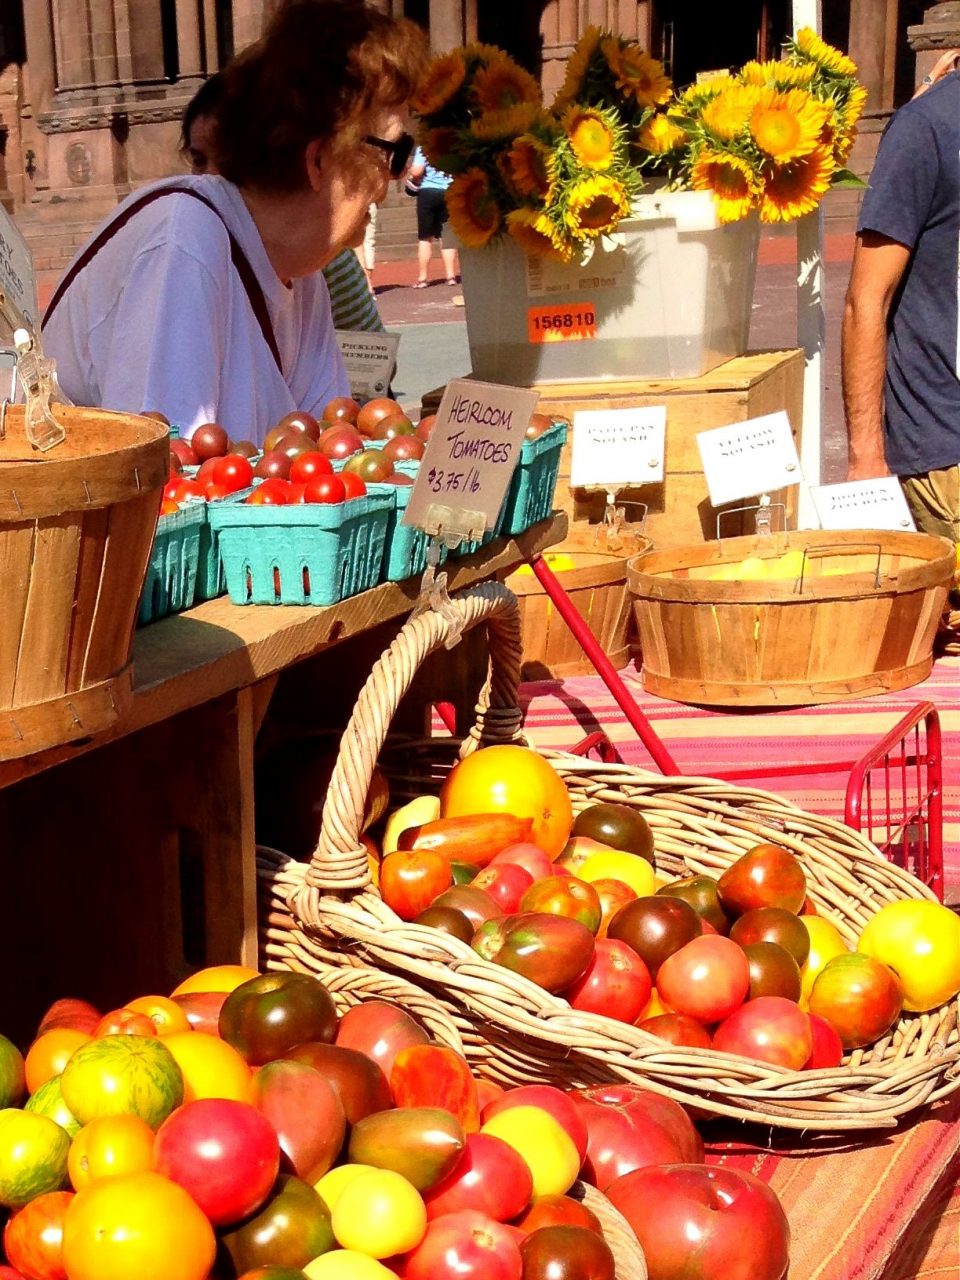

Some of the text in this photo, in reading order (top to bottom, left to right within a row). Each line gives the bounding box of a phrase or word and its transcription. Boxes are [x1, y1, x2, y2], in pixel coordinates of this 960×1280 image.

[533, 312, 595, 329] 156810
[342, 343, 387, 351] PICKLING
[448, 395, 513, 430] HEIRLOOM
[447, 431, 512, 463] TOMATOES
